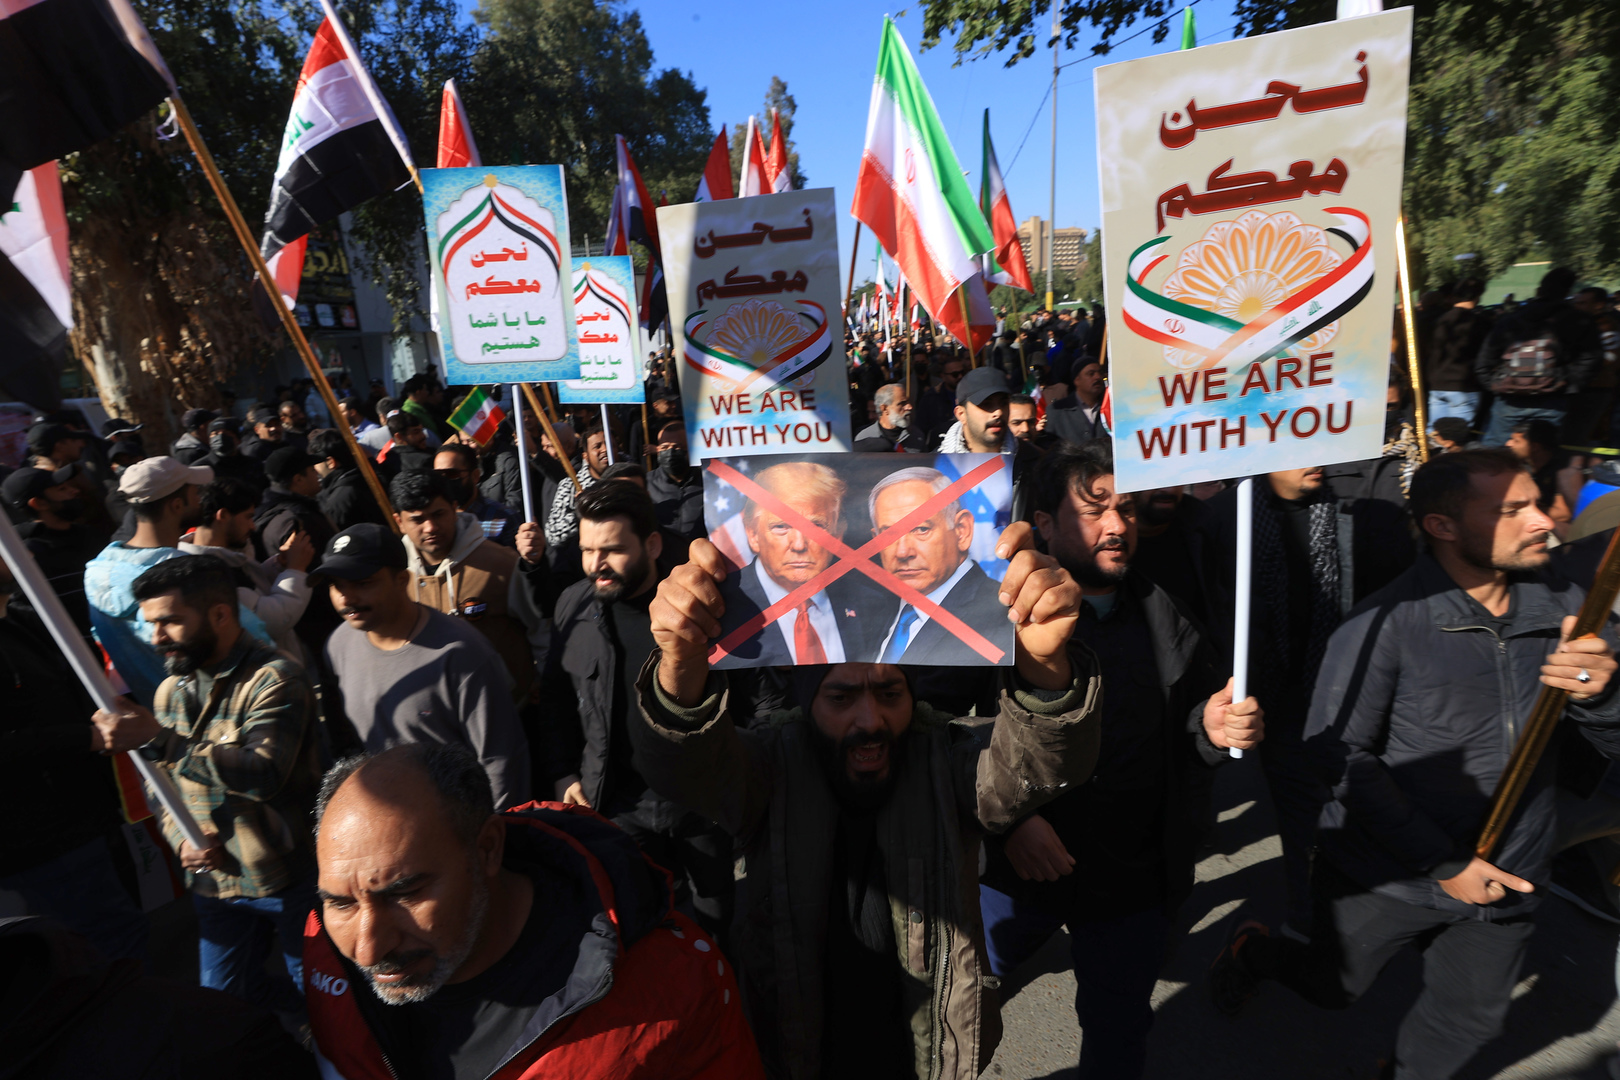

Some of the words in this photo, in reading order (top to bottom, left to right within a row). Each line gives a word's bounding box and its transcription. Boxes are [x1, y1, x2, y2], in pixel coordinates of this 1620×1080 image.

[1159, 49, 1369, 149] نحن
[1155, 156, 1350, 234] معكم
[694, 208, 814, 259] نحن
[471, 241, 528, 268] نحن
[466, 275, 541, 301] معكم
[696, 266, 809, 308] معكم
[469, 312, 498, 328] شما
[503, 312, 520, 331] با
[525, 311, 546, 326] ما
[576, 307, 610, 325] نحن
[579, 330, 618, 343] معك
[1158, 366, 1228, 407] WE
[1239, 351, 1335, 397] ARE
[710, 393, 752, 416] WE
[760, 389, 816, 413] ARE
[701, 425, 767, 448] WITH
[775, 421, 832, 446] YOU
[1136, 415, 1246, 460] WITH
[1262, 400, 1354, 443] YOU
